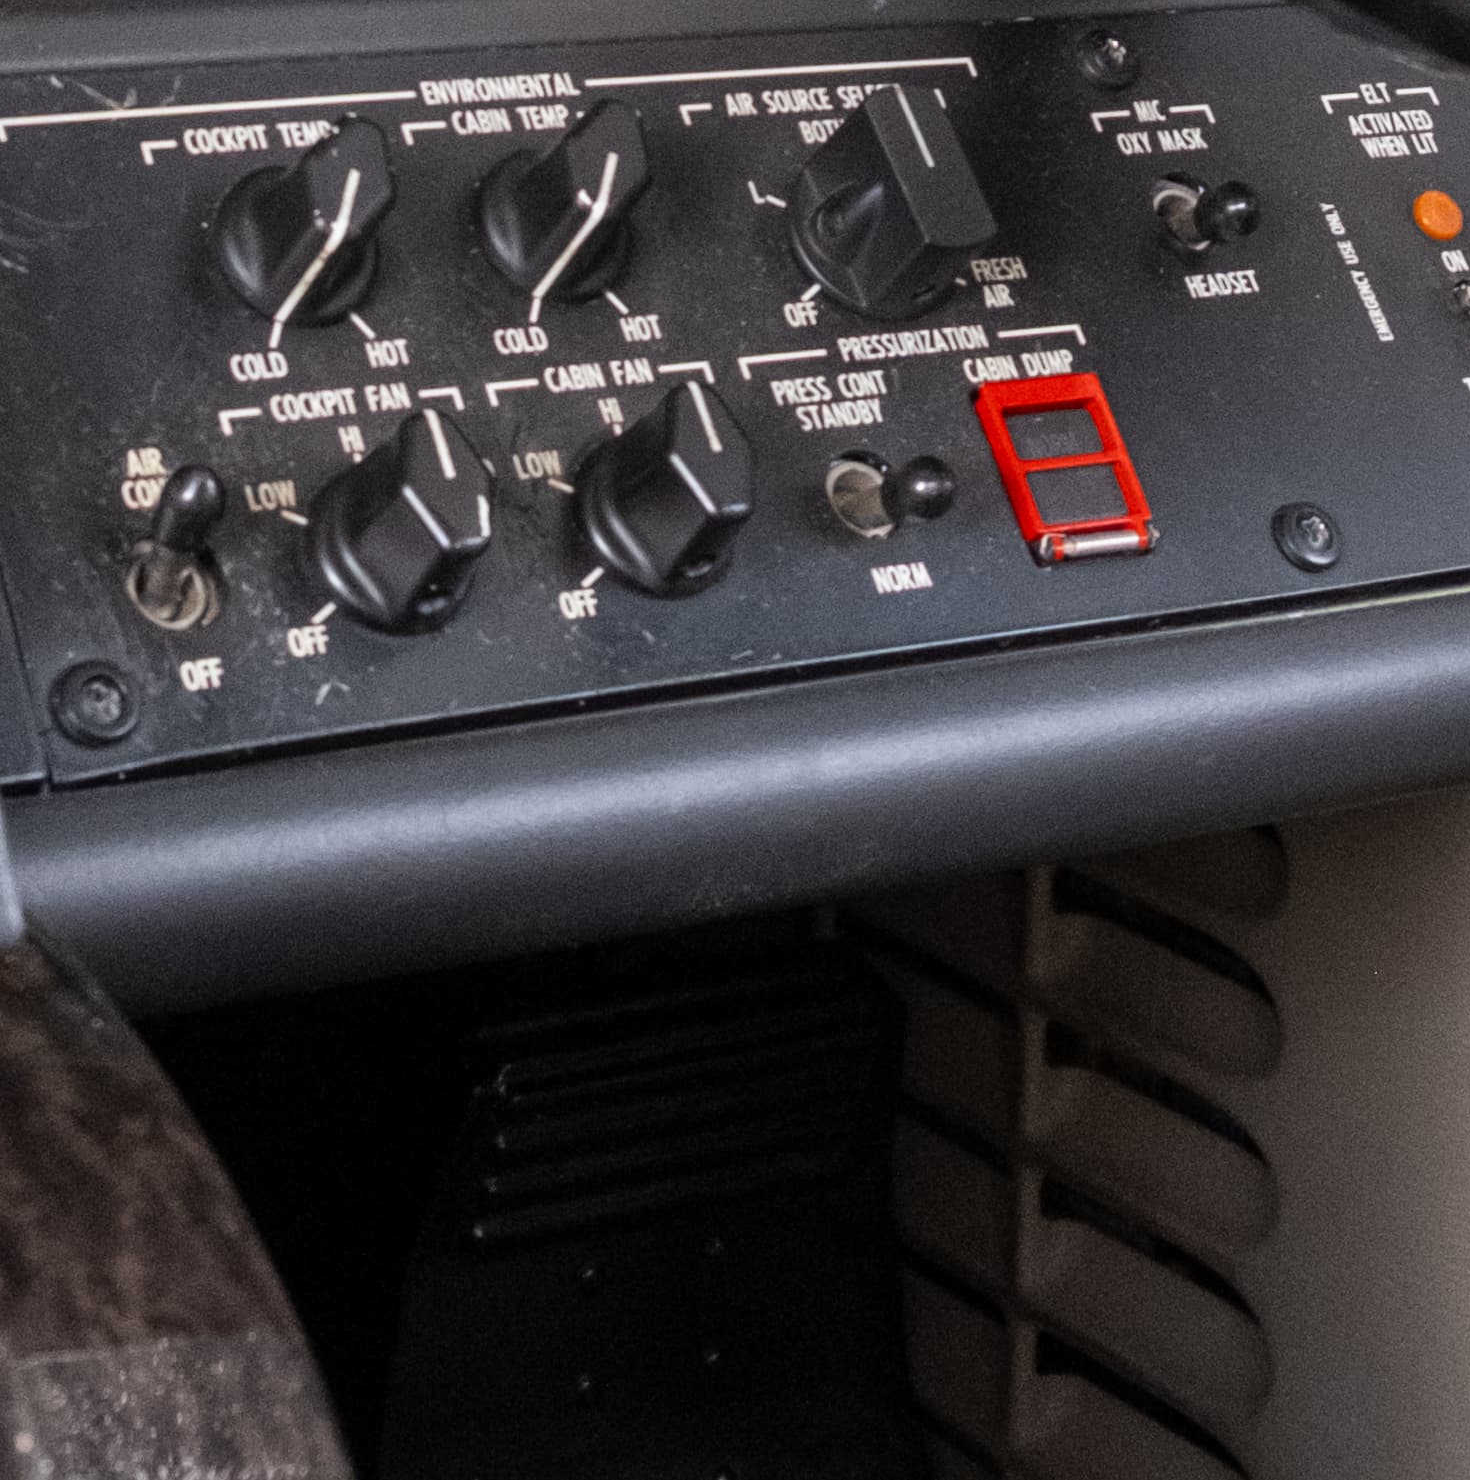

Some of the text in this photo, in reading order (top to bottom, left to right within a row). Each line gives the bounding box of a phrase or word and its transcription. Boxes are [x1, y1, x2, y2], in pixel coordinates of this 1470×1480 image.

[419, 72, 581, 105] ENVIRONMENTAL
[725, 88, 832, 117] AIR SOURCE
[1359, 82, 1391, 105] ELT
[451, 104, 569, 135] CABIN TEMP
[1133, 100, 1166, 123] MIC
[1348, 110, 1433, 137] ACTIVATED
[183, 125, 269, 155] COCKPIT
[1117, 128, 1208, 155] OXY MASK
[1360, 132, 1439, 159] WHEN LIT
[971, 257, 1028, 282] FRESH
[1441, 250, 1469, 273] ON
[983, 287, 1014, 308] AIR
[1184, 270, 1260, 299] HEADSET
[783, 302, 818, 327] OFF
[365, 339, 410, 368] HOT
[837, 325, 989, 362] PRESSURIZATION
[230, 352, 288, 382] COLD
[544, 358, 654, 393] CABIN FAN
[963, 350, 1074, 383] CABIN DUMP
[270, 382, 412, 422] COCKPIT FAN
[770, 371, 887, 406] PRESS CONT
[795, 399, 884, 432] STANDBY
[245, 480, 297, 512] LOW
[871, 562, 933, 594] NORM
[558, 589, 598, 620] OFF
[287, 625, 329, 658] OFF
[180, 657, 224, 691] OFF
